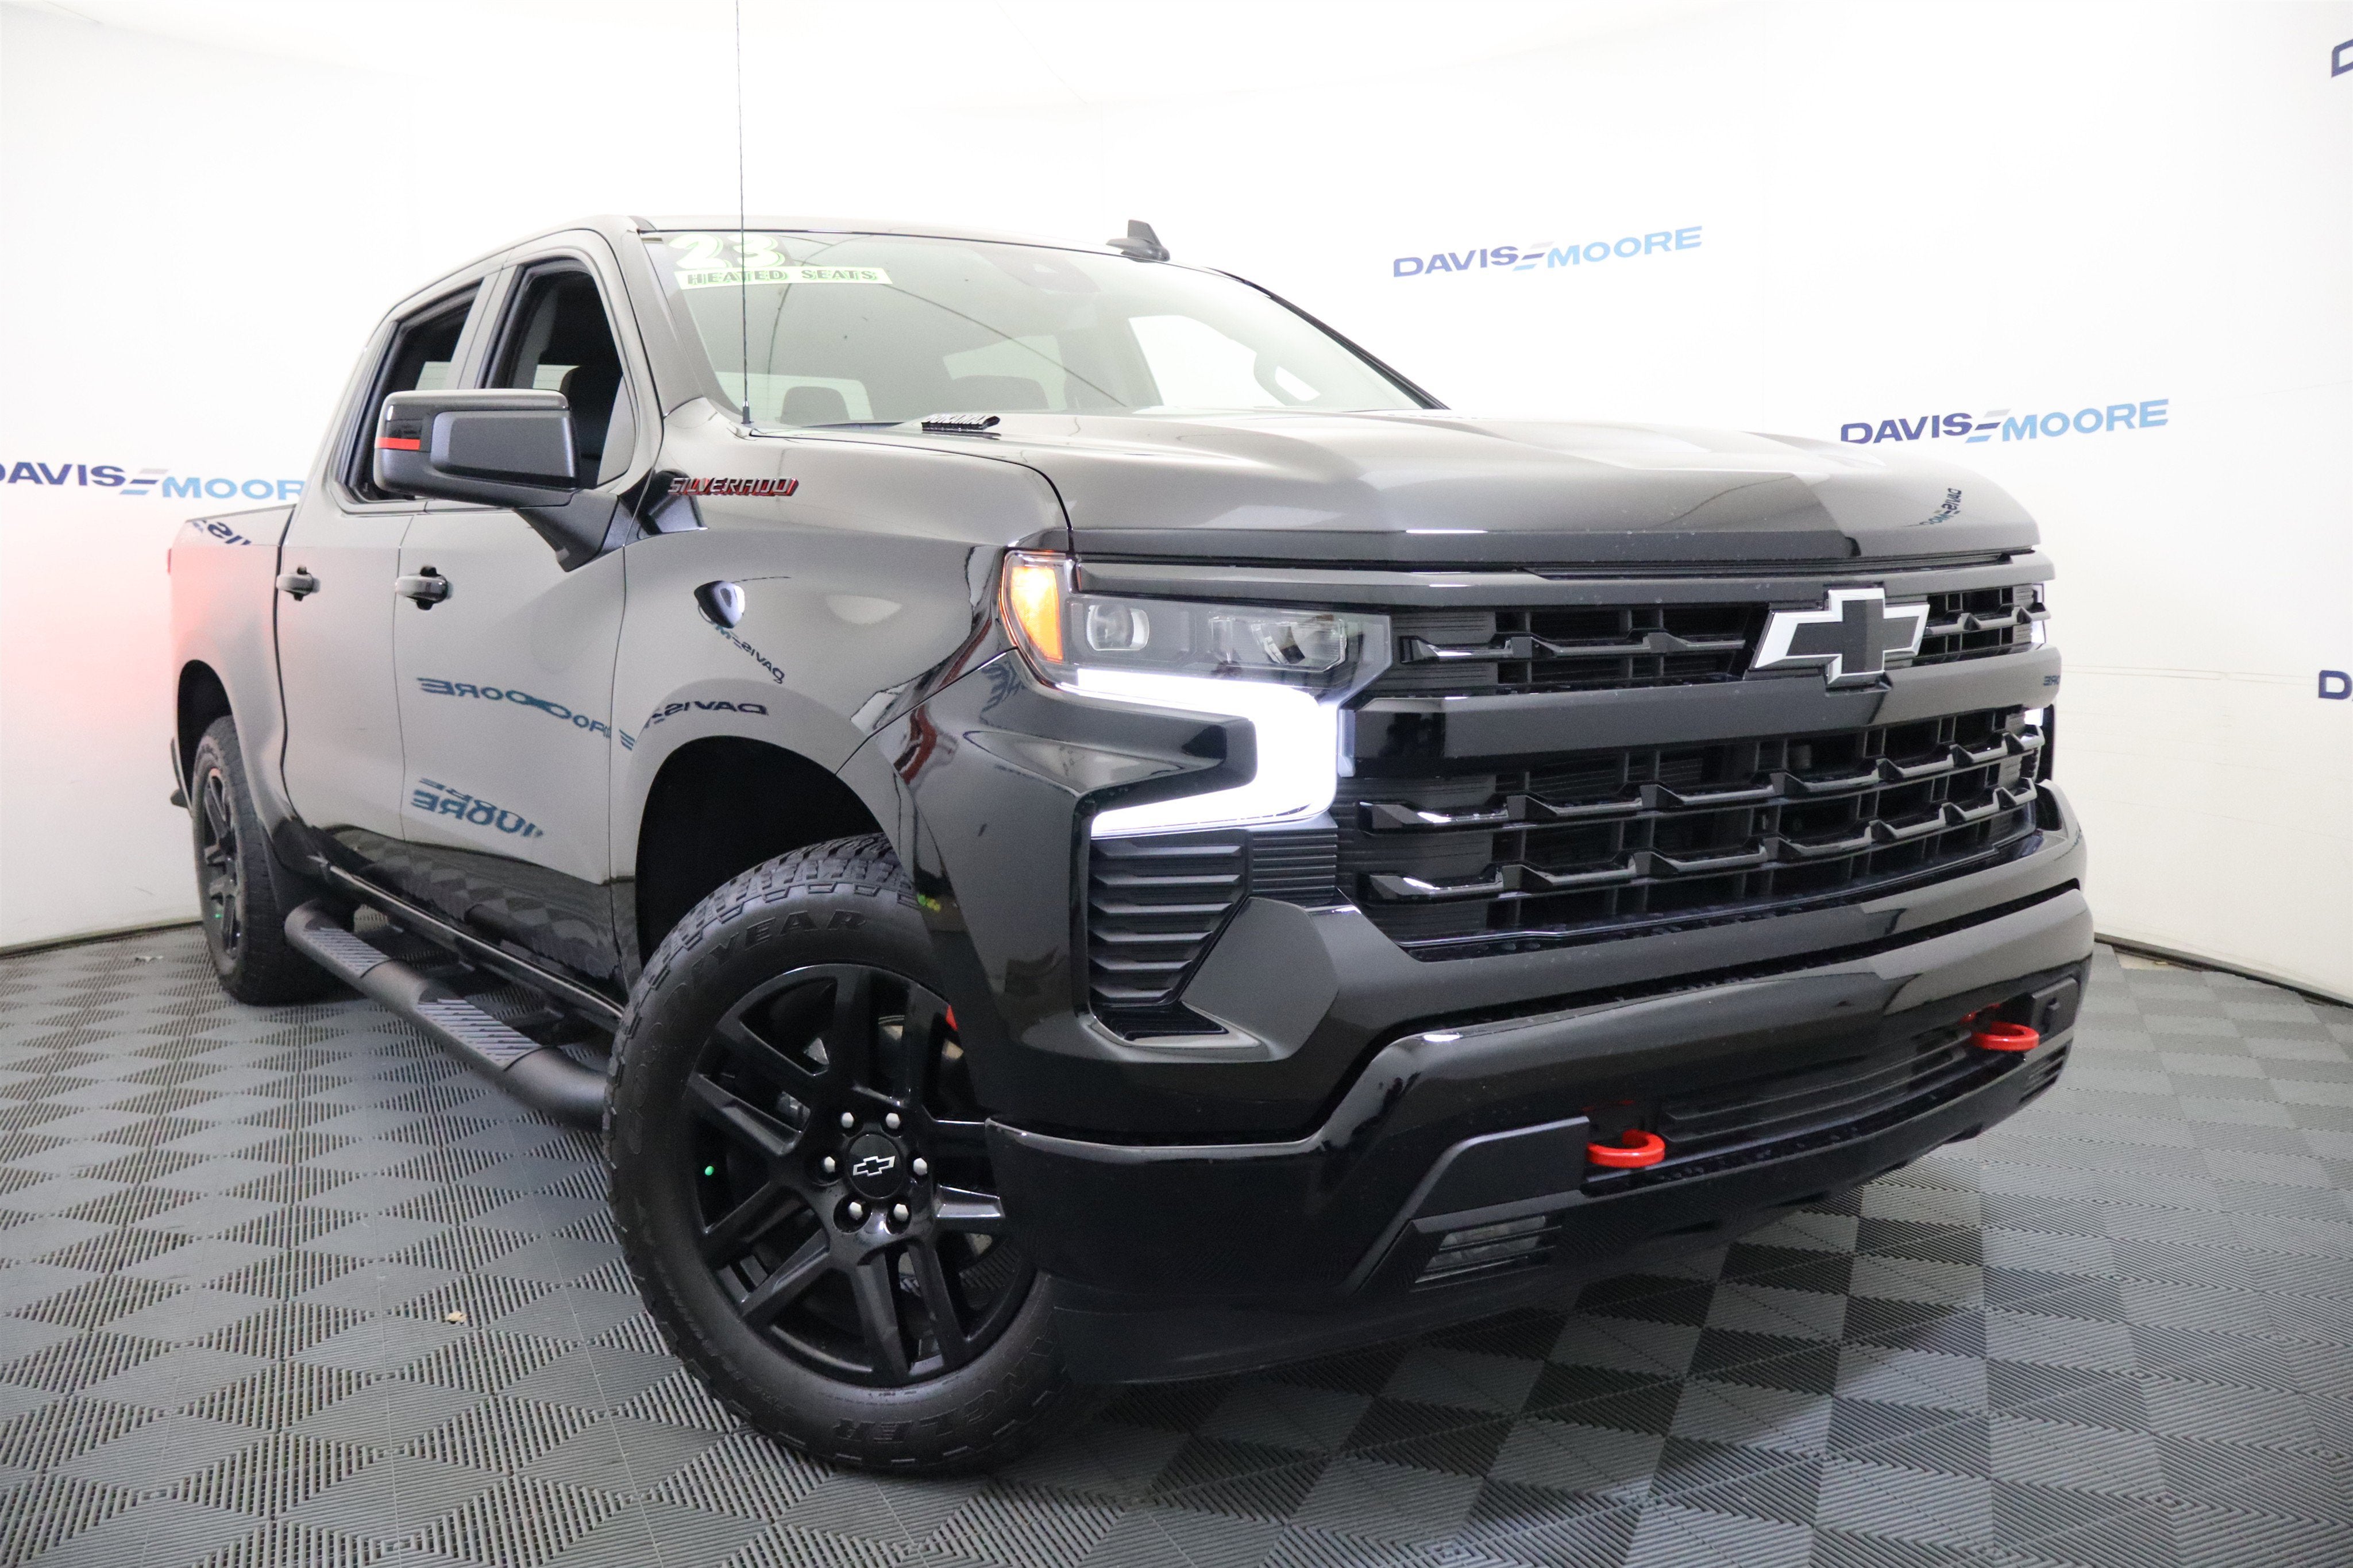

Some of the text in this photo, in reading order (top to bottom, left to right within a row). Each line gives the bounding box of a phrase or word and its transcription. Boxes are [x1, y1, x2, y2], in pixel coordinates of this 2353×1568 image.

[669, 233, 785, 268] 23
[1393, 225, 1702, 277] DAVIS MOORE
[687, 269, 879, 286] HEATED SEATS
[1841, 399, 2169, 444] DAVIS MOORE
[0, 462, 306, 500] AVIS MOOR
[668, 477, 799, 496] SILVERADO
